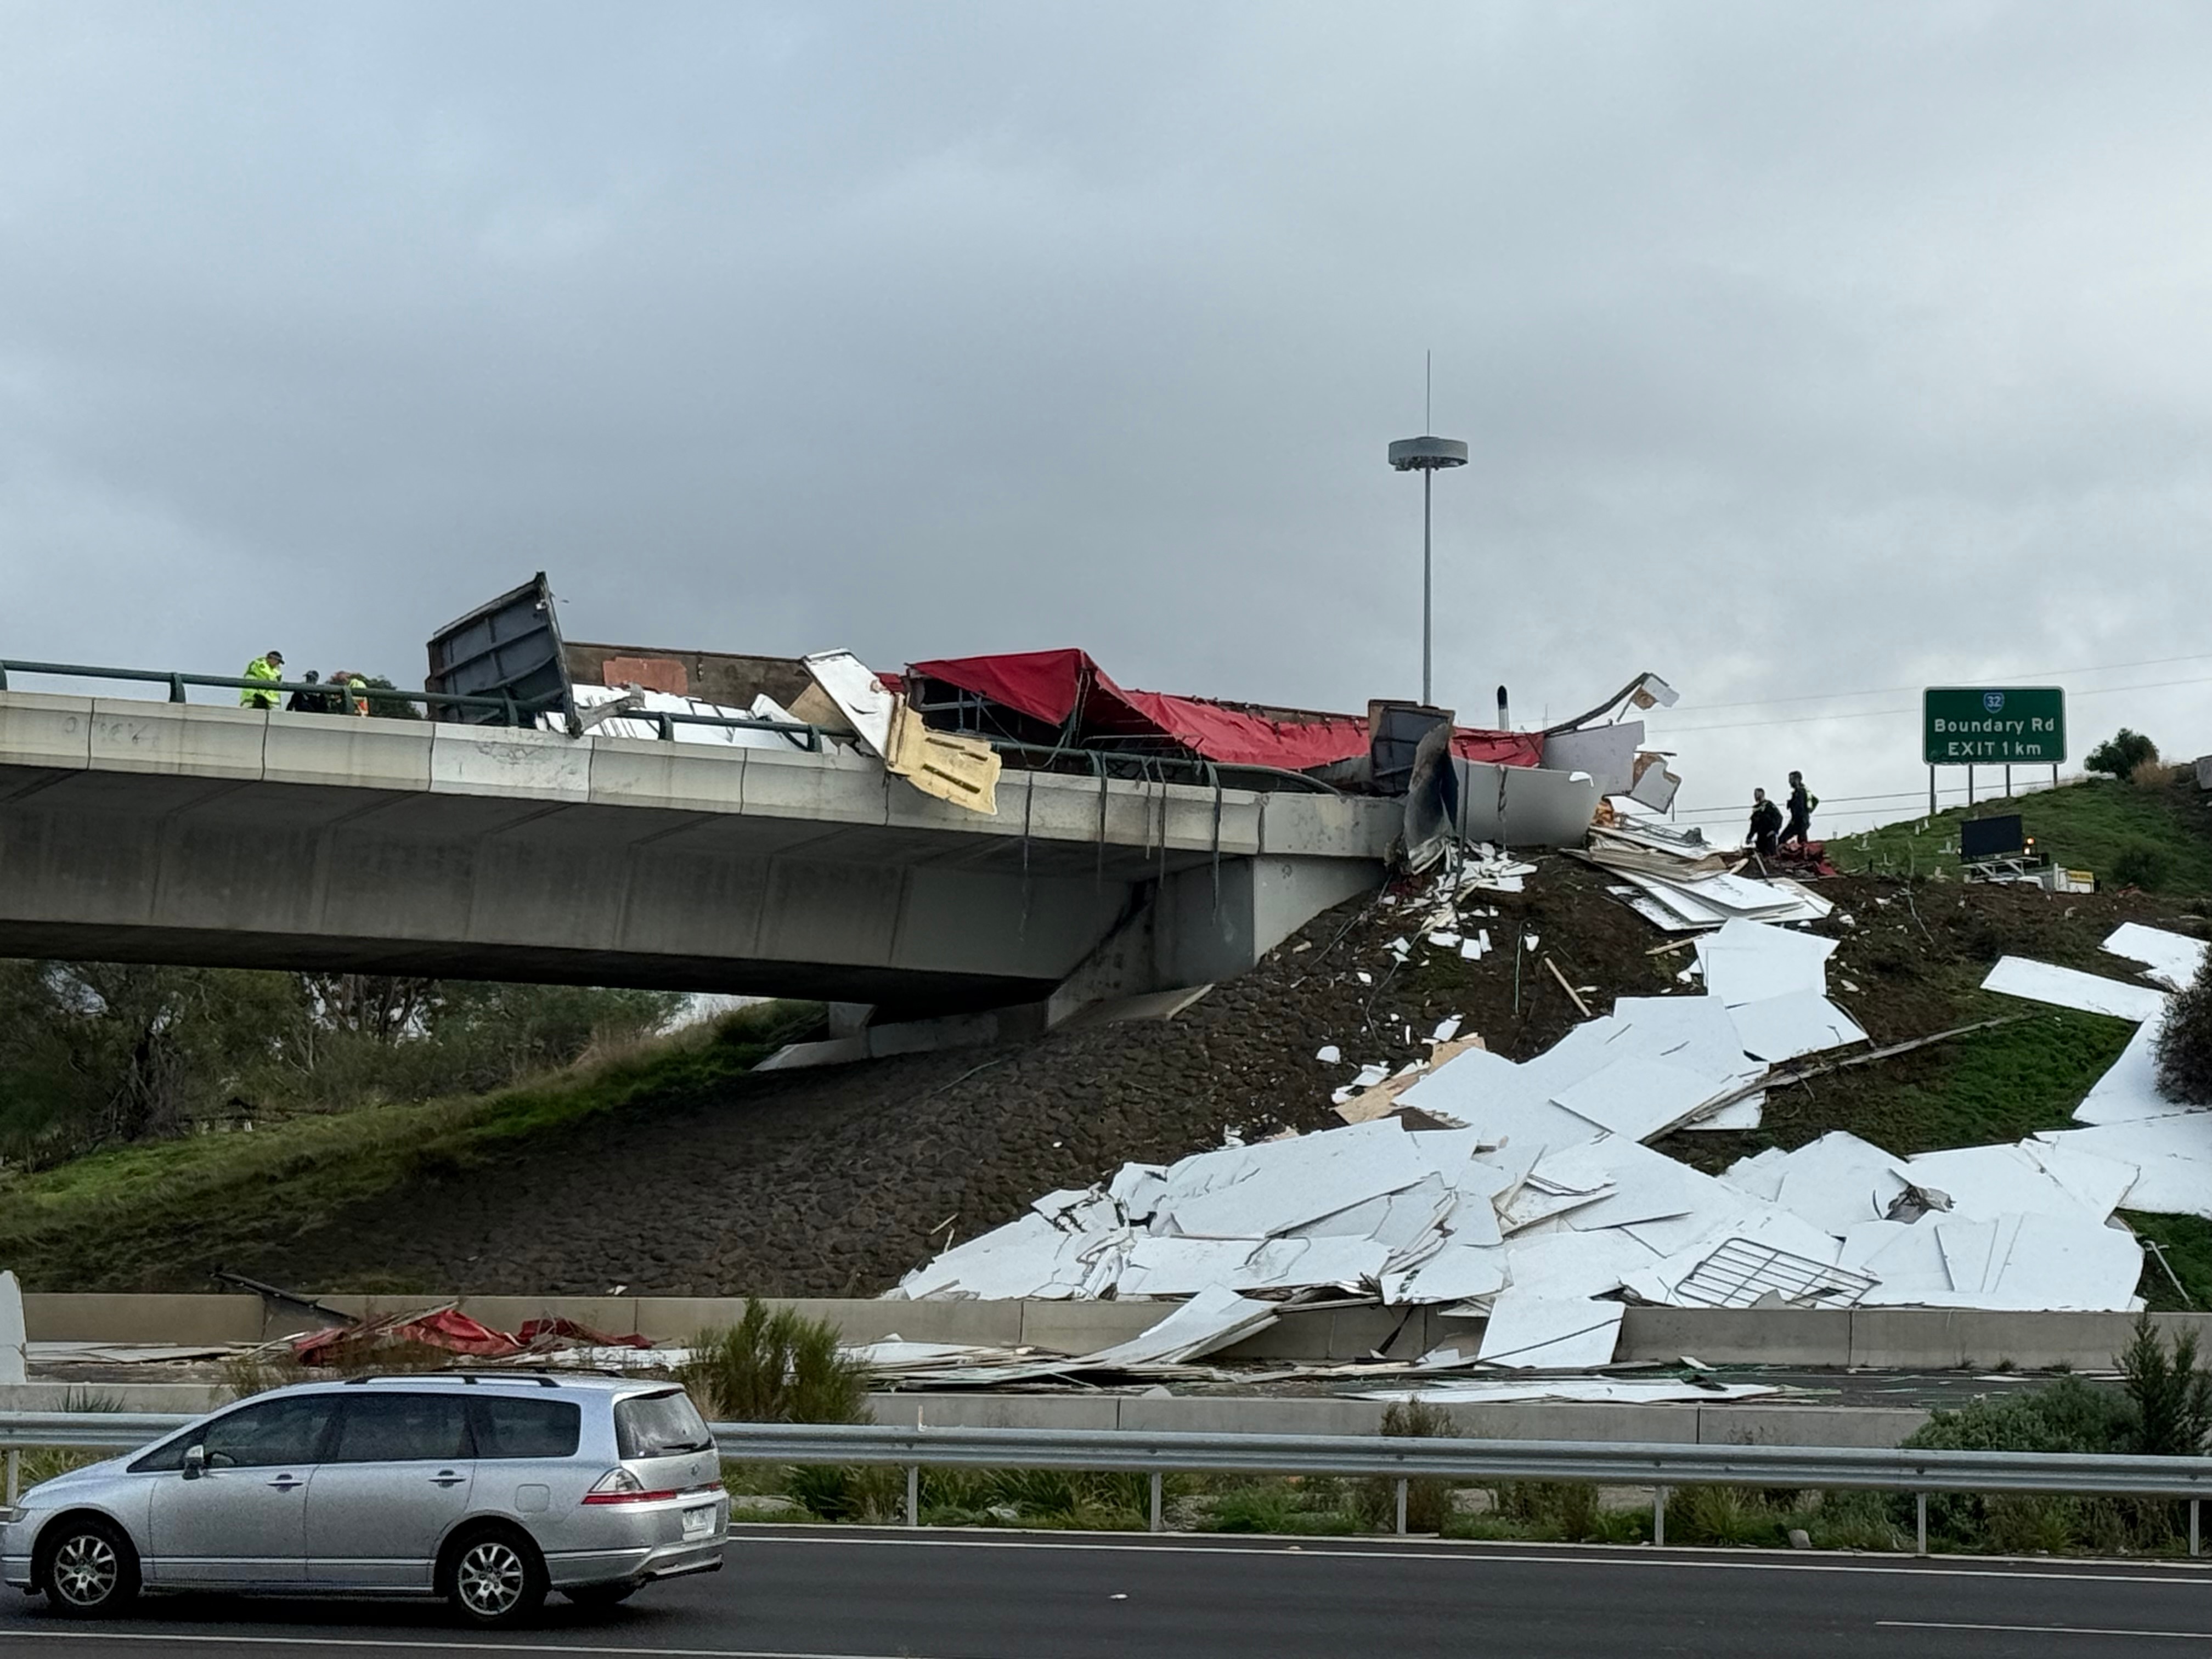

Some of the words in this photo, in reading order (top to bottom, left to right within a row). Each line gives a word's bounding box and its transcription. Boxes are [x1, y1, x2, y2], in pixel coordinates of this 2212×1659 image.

[1987, 696, 2002, 708] 32
[1934, 718, 2024, 735] Boundary
[2032, 717, 2054, 731] Rd
[1948, 742, 1995, 756] EXIT
[2002, 742, 2008, 755] 1
[2016, 742, 2041, 755] km
